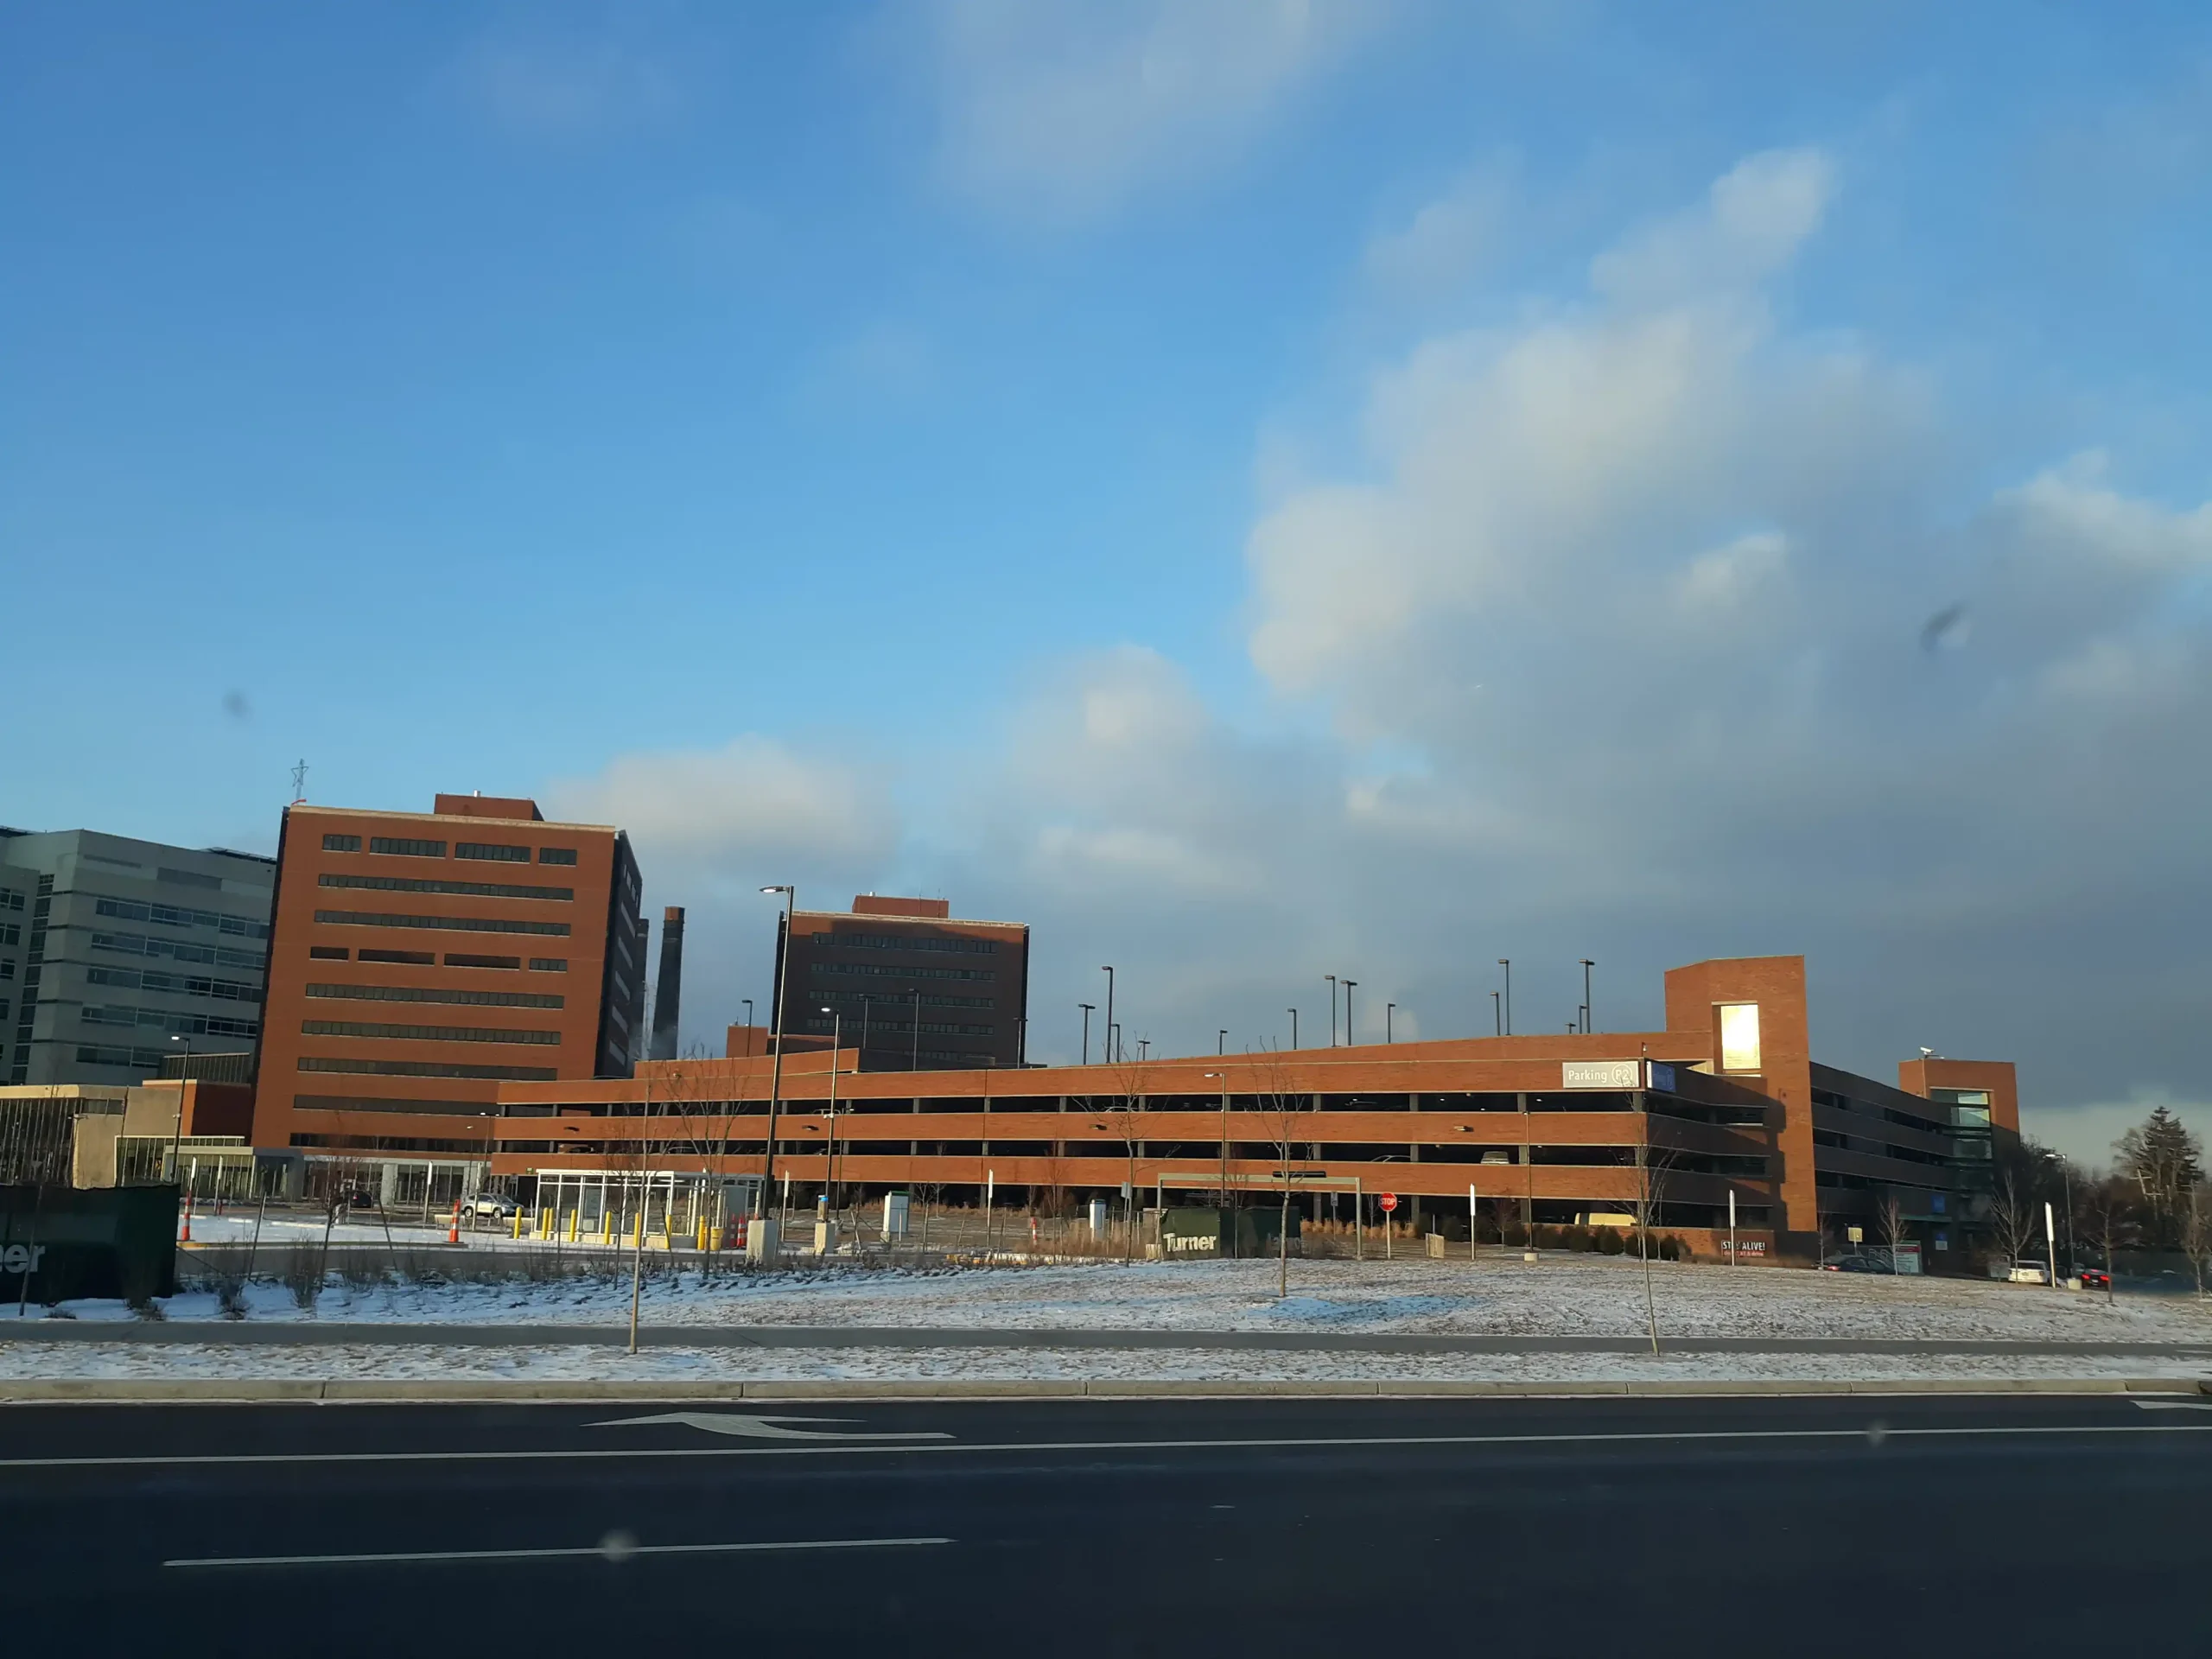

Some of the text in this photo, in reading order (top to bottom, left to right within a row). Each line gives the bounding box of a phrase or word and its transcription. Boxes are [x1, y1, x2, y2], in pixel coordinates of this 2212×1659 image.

[1568, 1070, 1607, 1084] Parking
[1163, 1233, 1217, 1252] Turner
[1722, 1241, 1765, 1251] STY ALIVE!
[0, 1244, 46, 1274] er
